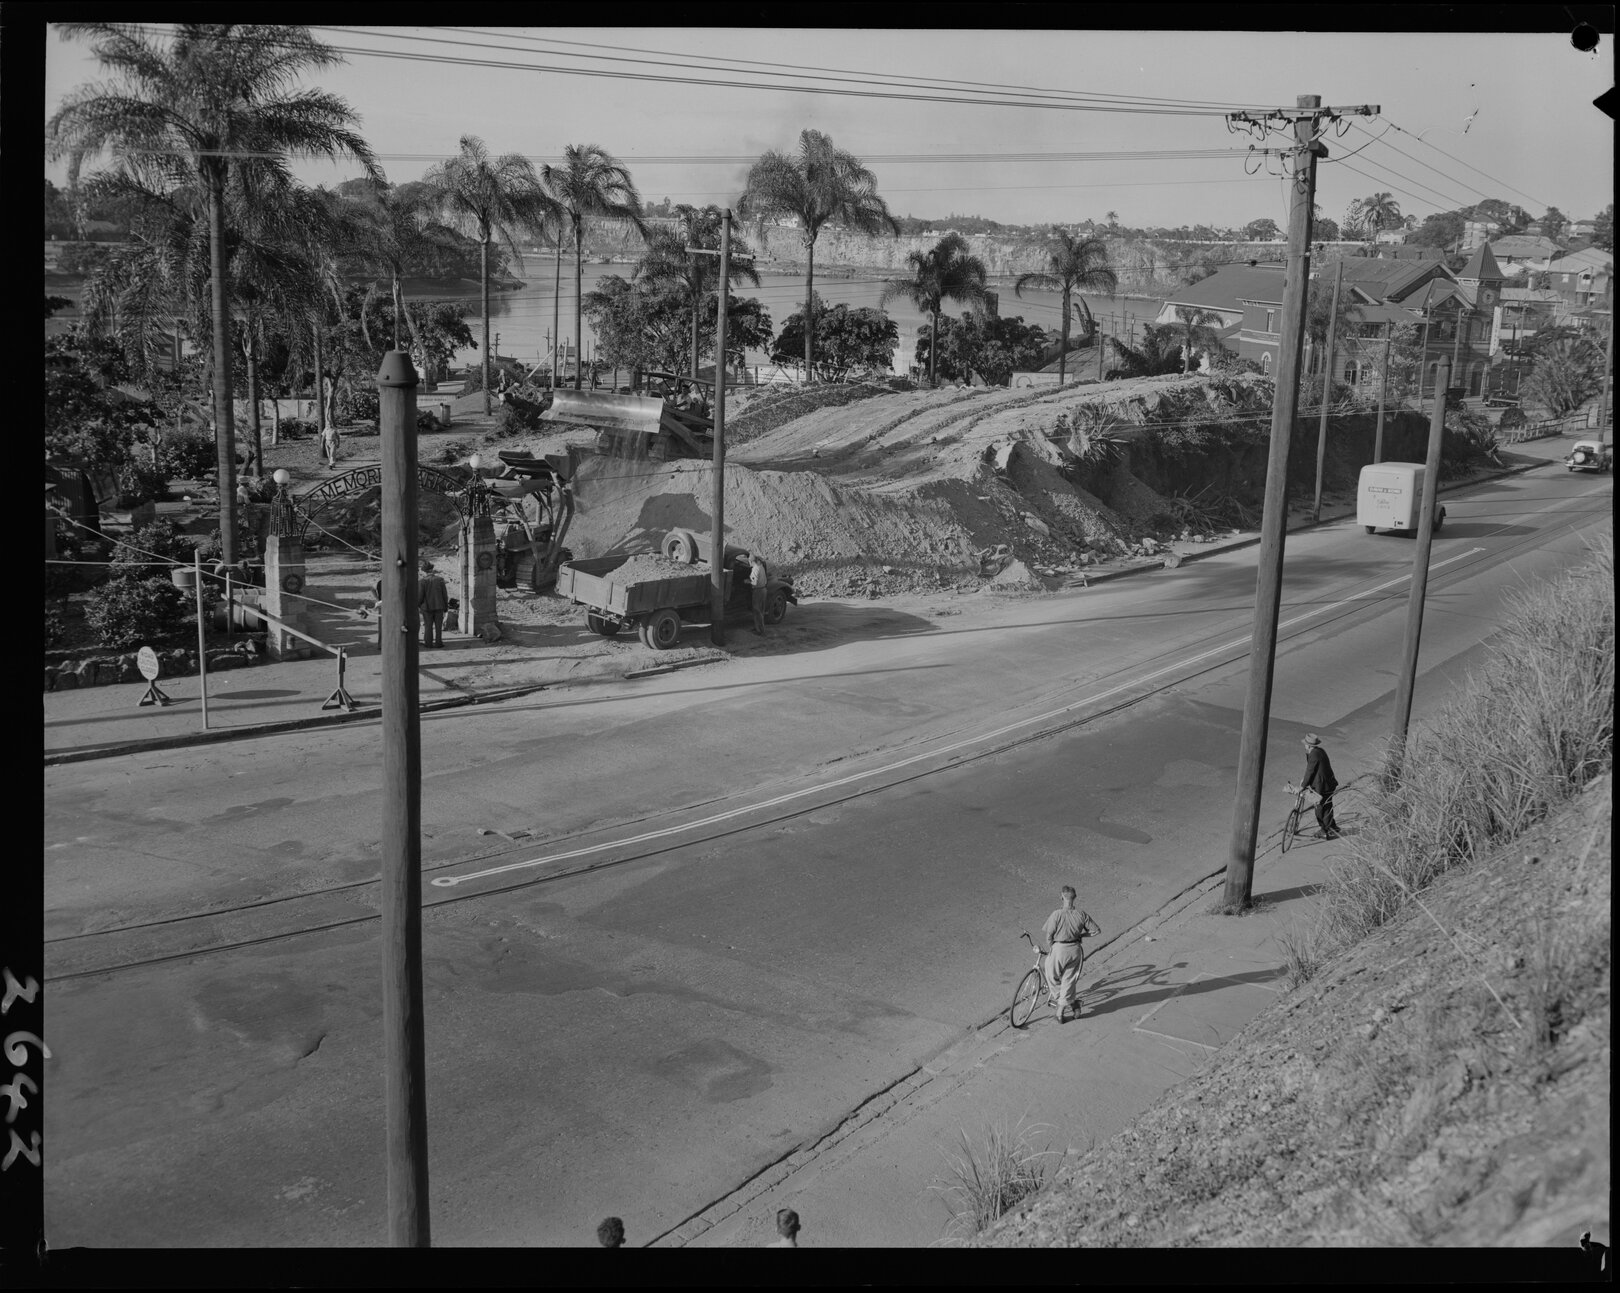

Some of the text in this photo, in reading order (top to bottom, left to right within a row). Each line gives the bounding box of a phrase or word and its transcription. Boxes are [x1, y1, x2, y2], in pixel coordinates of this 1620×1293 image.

[320, 467, 445, 501] MEMORI ARK
[0, 966, 52, 1172] 2642
